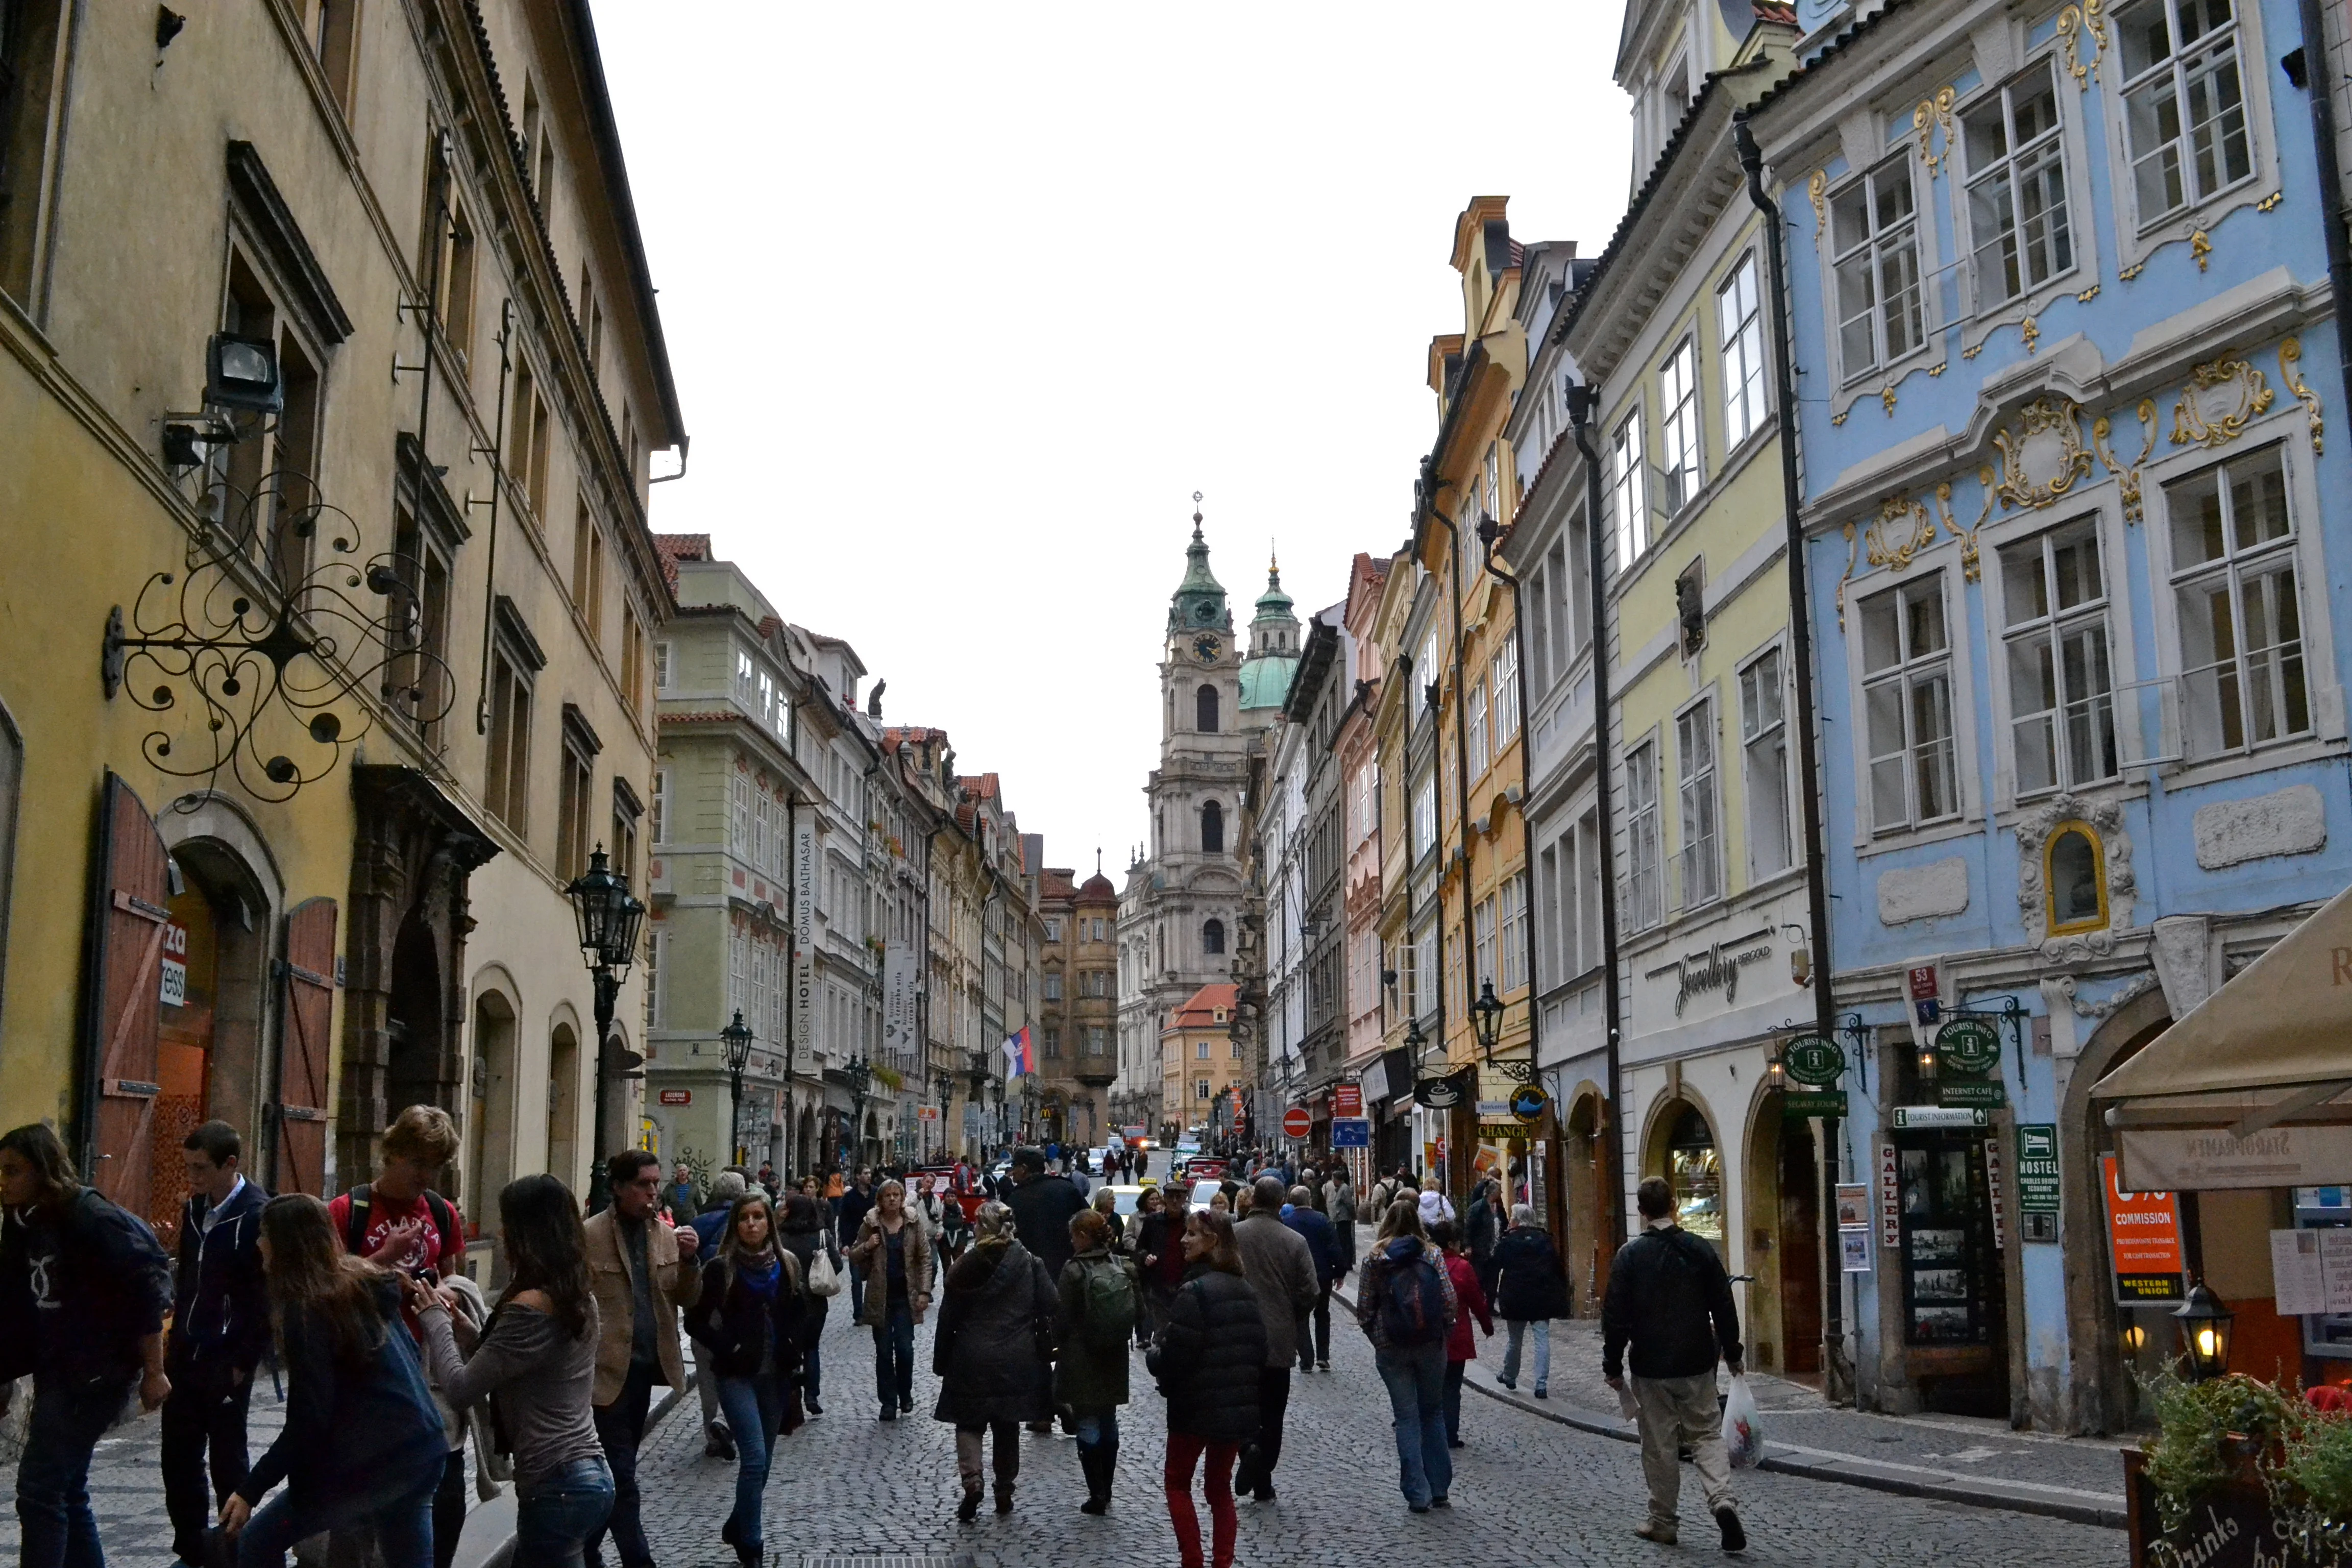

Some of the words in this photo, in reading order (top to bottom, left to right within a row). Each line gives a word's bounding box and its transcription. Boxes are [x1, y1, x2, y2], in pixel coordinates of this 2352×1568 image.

[800, 833, 811, 896] BALTHASAR
[800, 901, 810, 944] DOMUS
[163, 923, 187, 955] za
[799, 964, 809, 1009] HOTEL
[1675, 942, 1737, 1016] Jewellery
[1916, 968, 1927, 982] 53
[799, 1014, 809, 1059] DESIGN
[1942, 1022, 1973, 1038] TOURIST
[1975, 1023, 1993, 1039] INFO
[1788, 1038, 1819, 1053] TOURIST
[1821, 1039, 1837, 1054] INFO
[1932, 1112, 1972, 1121] INFORMATION
[1478, 1125, 1528, 1137] CHANGE
[2020, 1161, 2057, 1174] HOSTEL
[1882, 1148, 1898, 1243] GALLERY
[2116, 1212, 2171, 1225] COMMISSION
